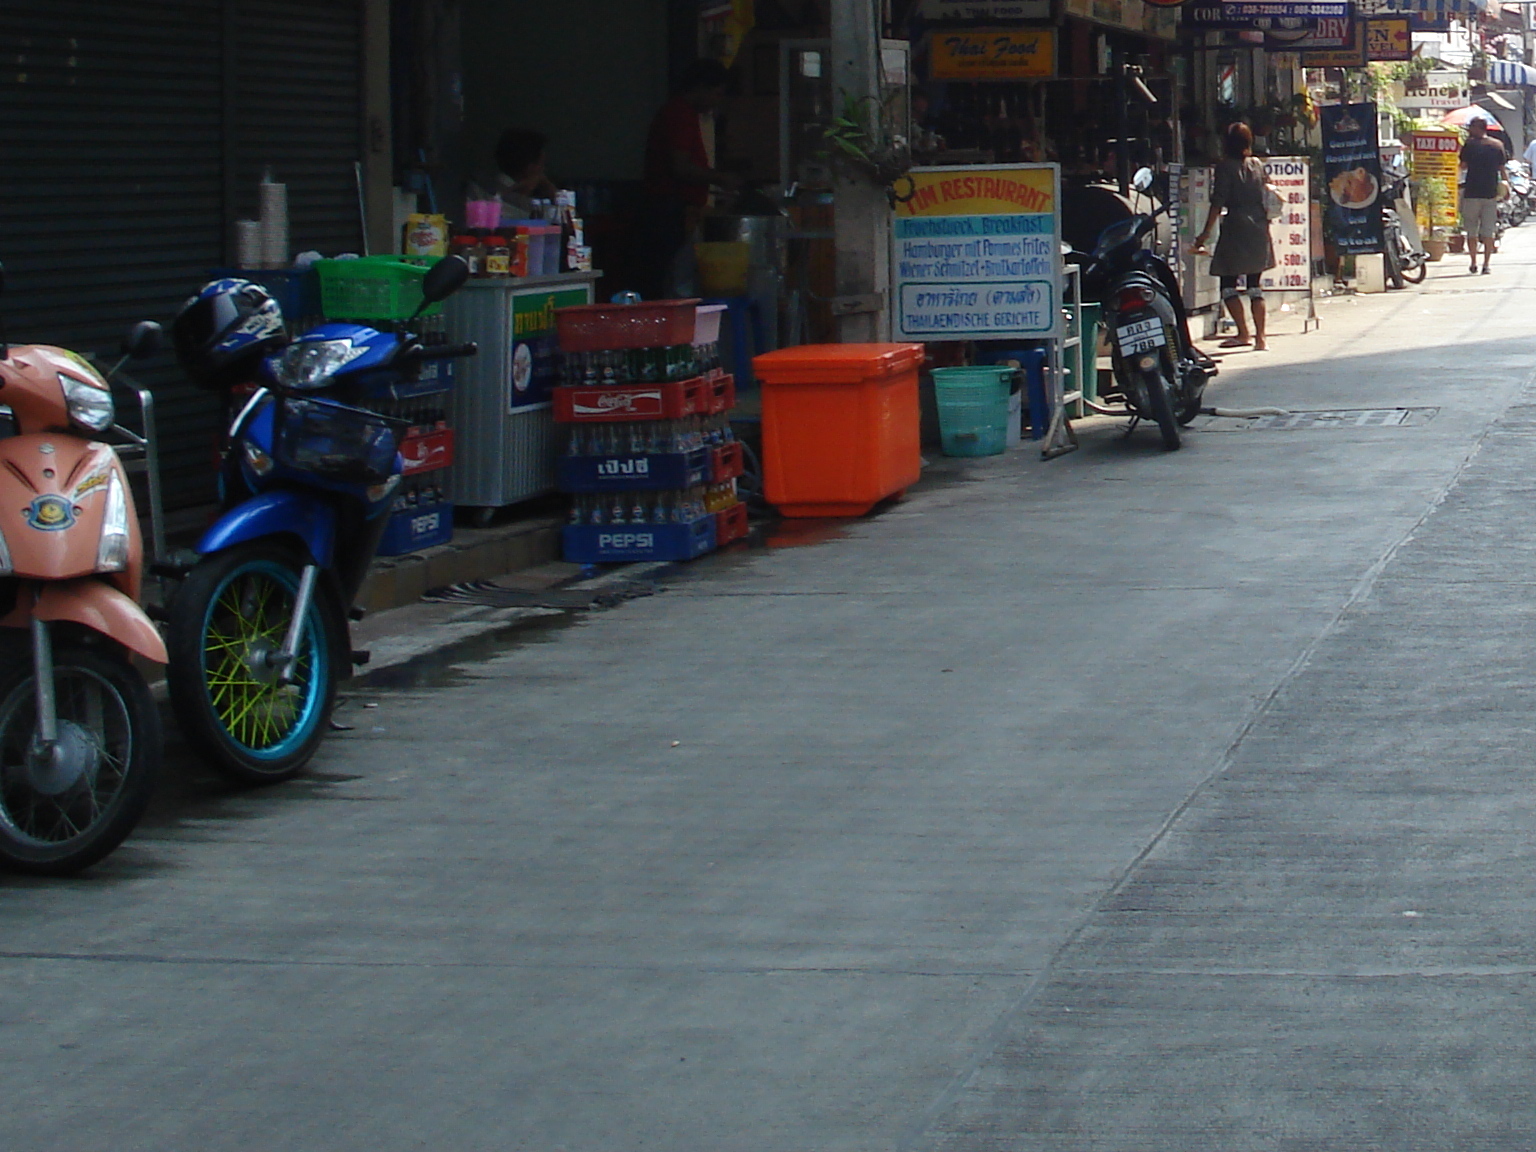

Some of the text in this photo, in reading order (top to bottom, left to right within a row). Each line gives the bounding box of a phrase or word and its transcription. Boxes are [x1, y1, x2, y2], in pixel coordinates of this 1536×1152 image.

[944, 37, 1039, 59] Thai Food
[1416, 137, 1436, 150] TAXI
[940, 177, 1052, 212] RESTAURANT
[995, 311, 1040, 327] GERICHTE
[411, 512, 441, 534] PEPSI
[599, 532, 654, 548] PEPSI
